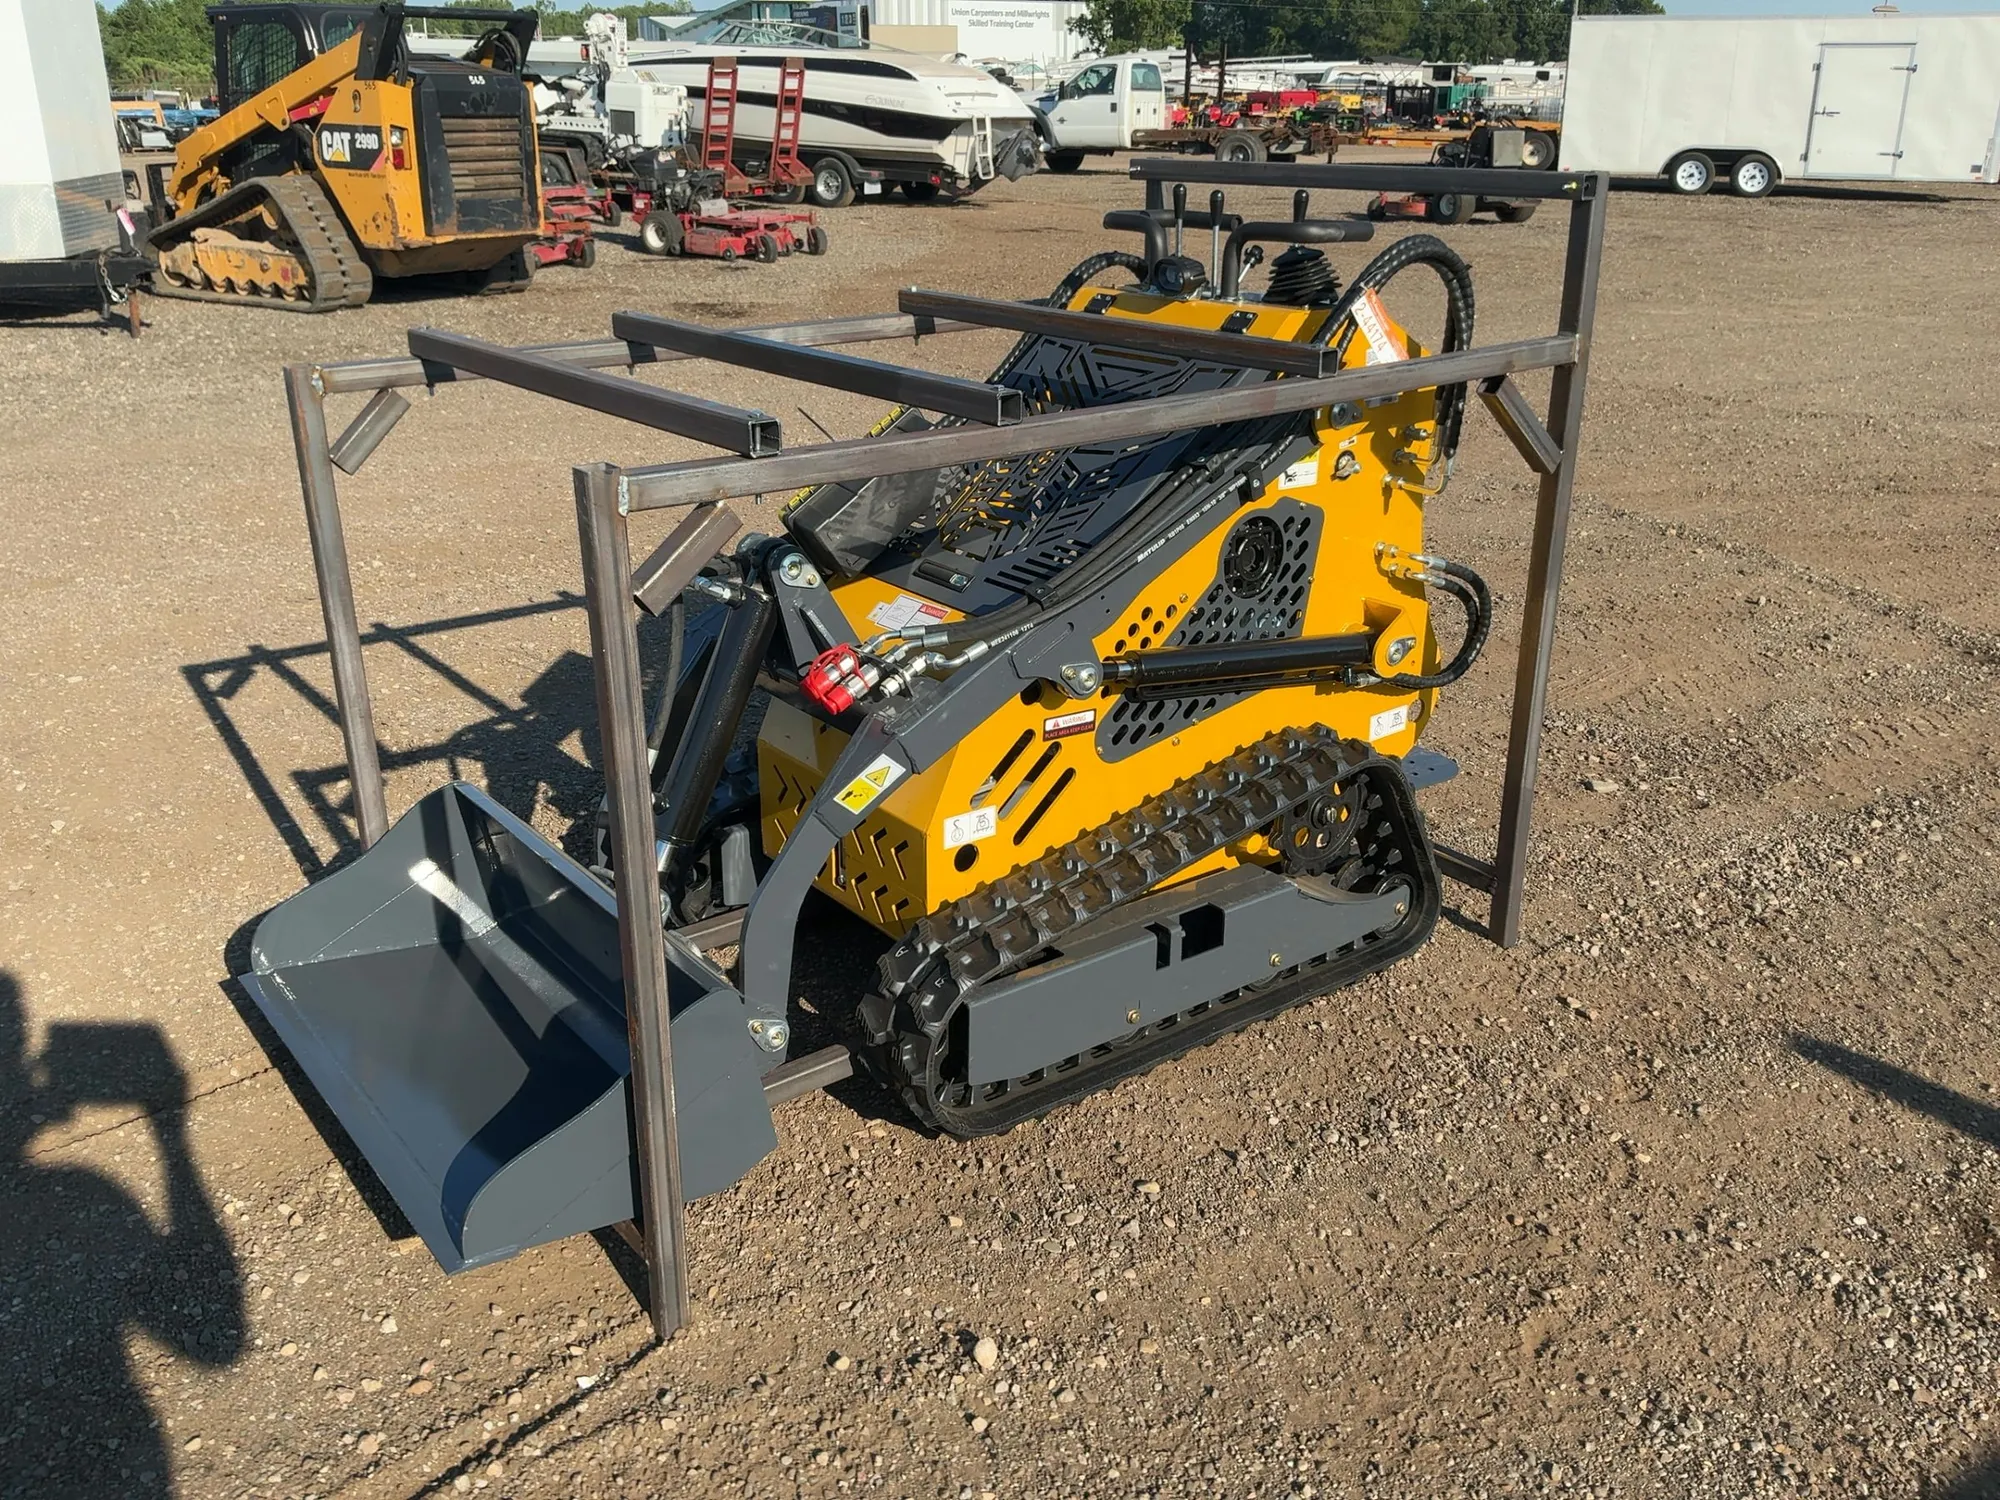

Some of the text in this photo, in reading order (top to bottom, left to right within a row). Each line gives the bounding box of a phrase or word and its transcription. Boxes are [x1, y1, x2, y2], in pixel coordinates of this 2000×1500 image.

[951, 8, 1050, 19] Union Carpenters and Millwrights
[968, 19, 1035, 29] Skilled Training Center
[321, 130, 379, 162] CAT 299D
